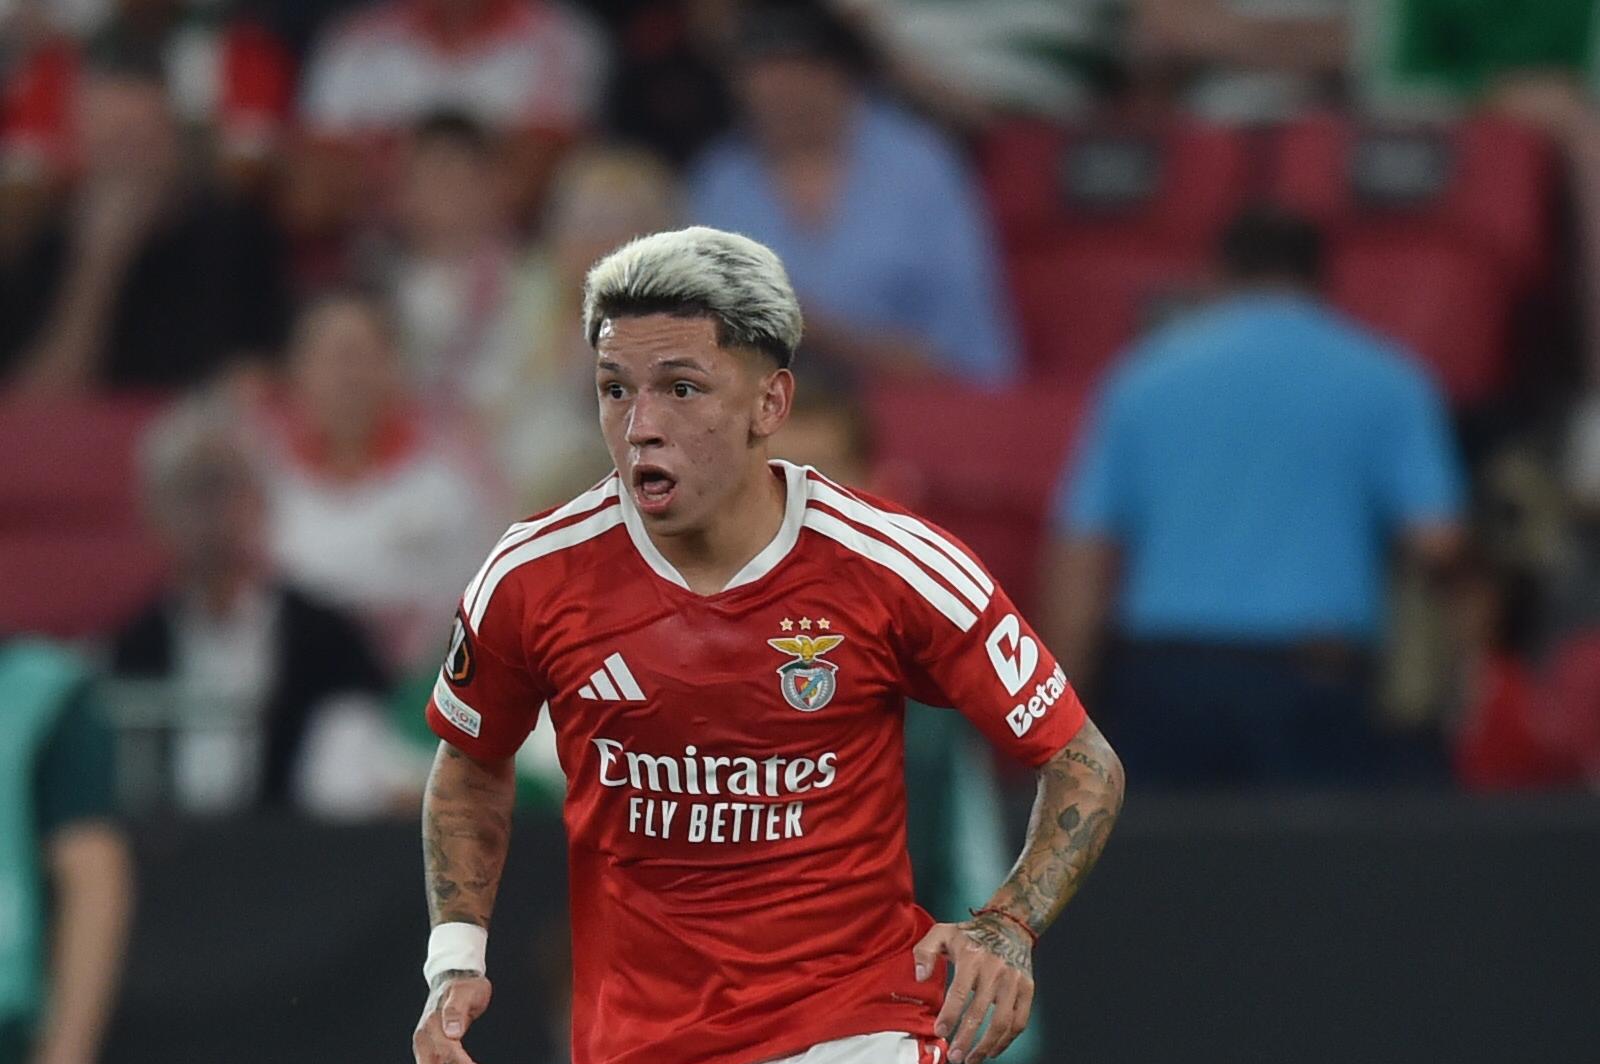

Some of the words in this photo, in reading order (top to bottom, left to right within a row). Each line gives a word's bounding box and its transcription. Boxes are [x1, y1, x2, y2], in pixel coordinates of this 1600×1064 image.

[591, 738, 838, 797] Emirates
[629, 797, 678, 839] FLY
[688, 801, 804, 843] BETTER
